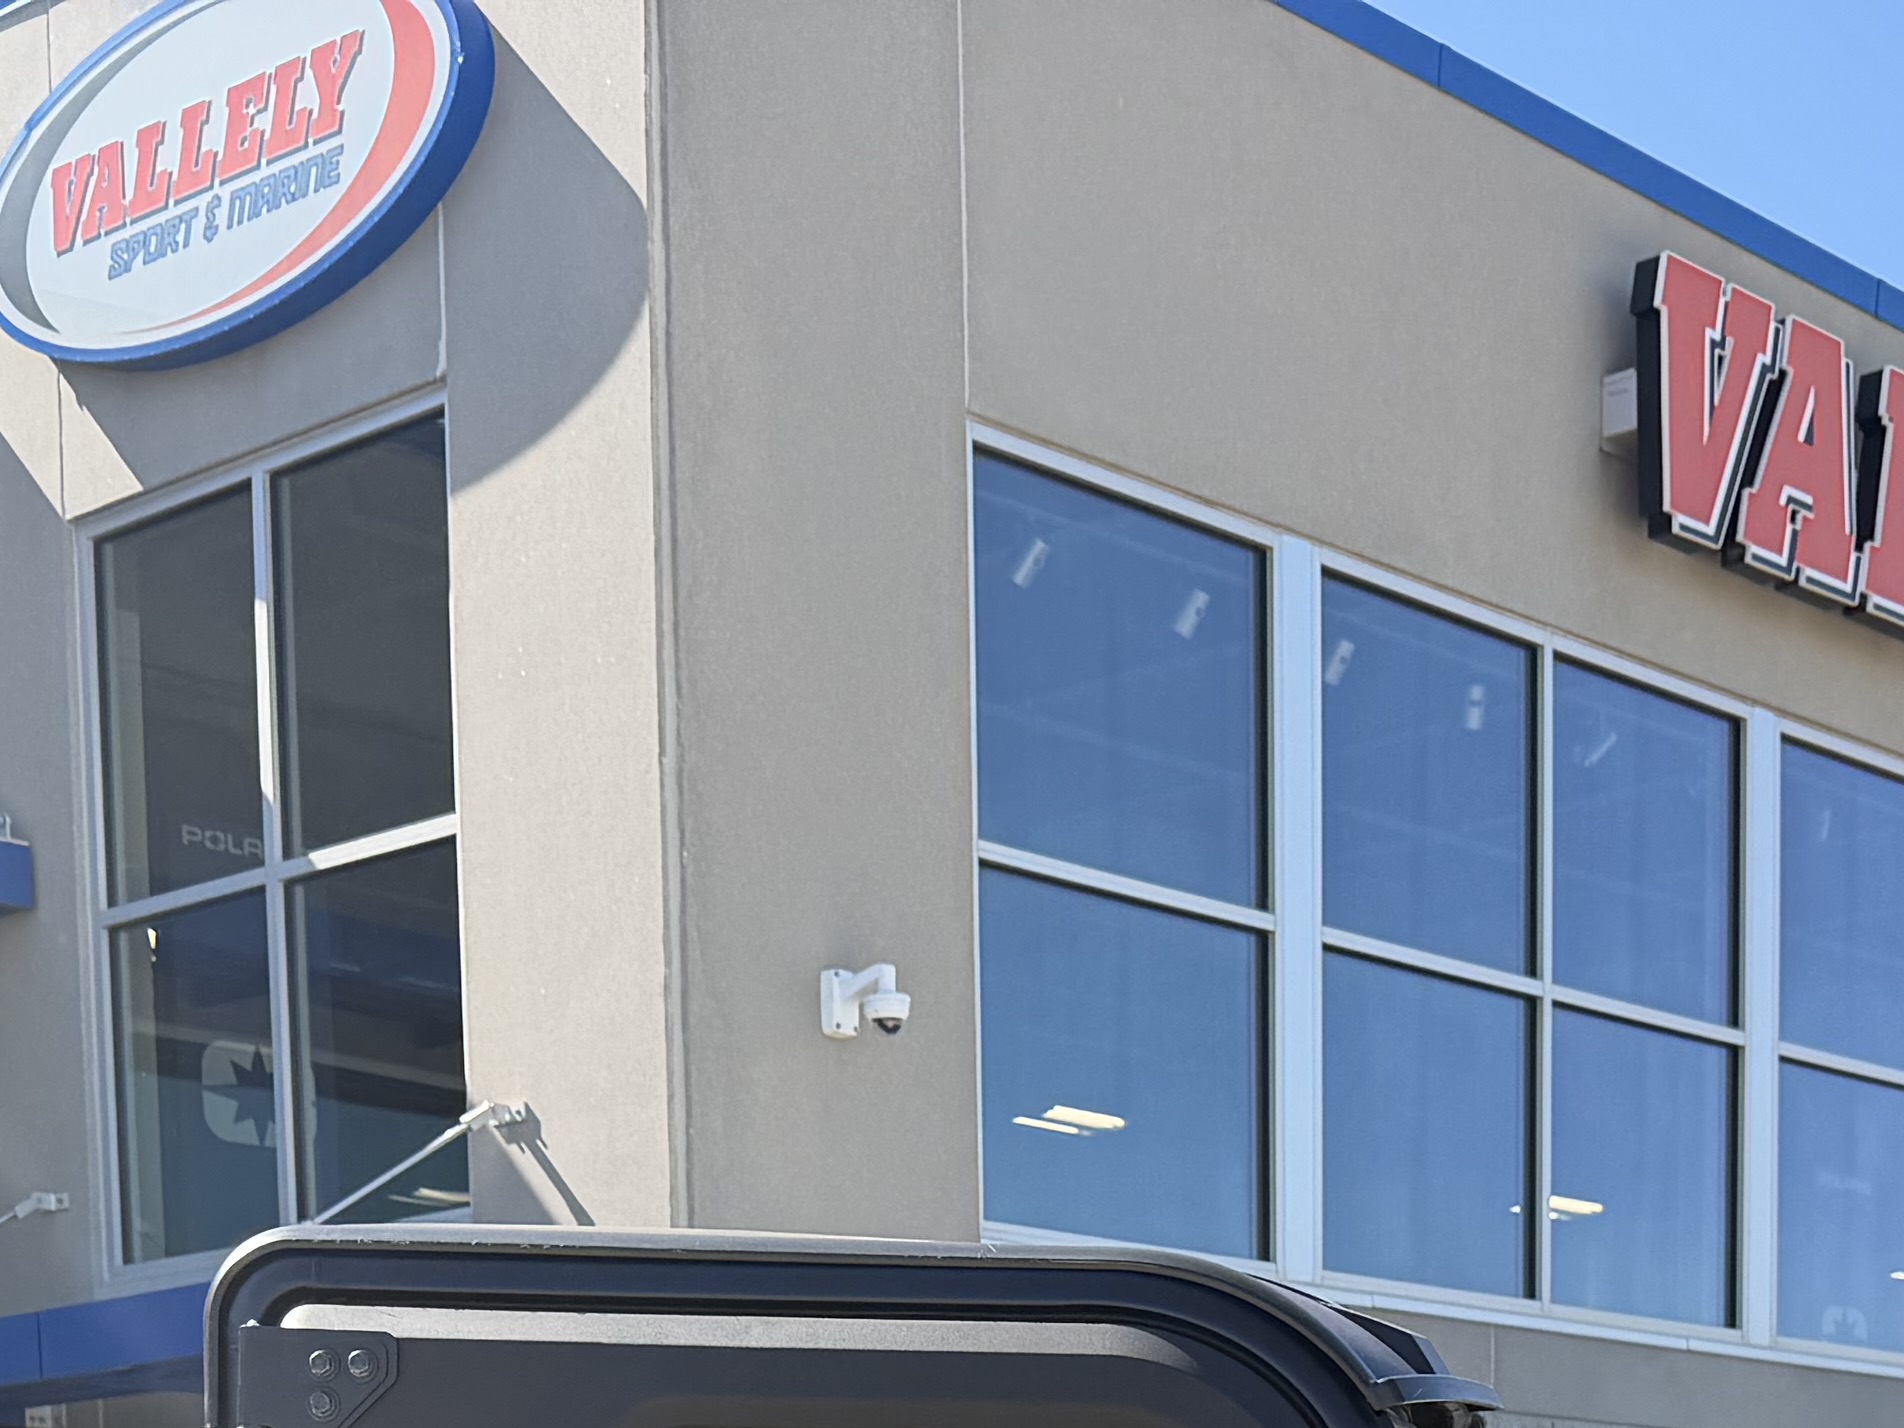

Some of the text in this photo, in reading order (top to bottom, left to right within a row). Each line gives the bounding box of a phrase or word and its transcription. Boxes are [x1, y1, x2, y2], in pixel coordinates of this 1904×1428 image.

[49, 29, 365, 256] VALLELY
[108, 144, 345, 280] SPORT & MARINE
